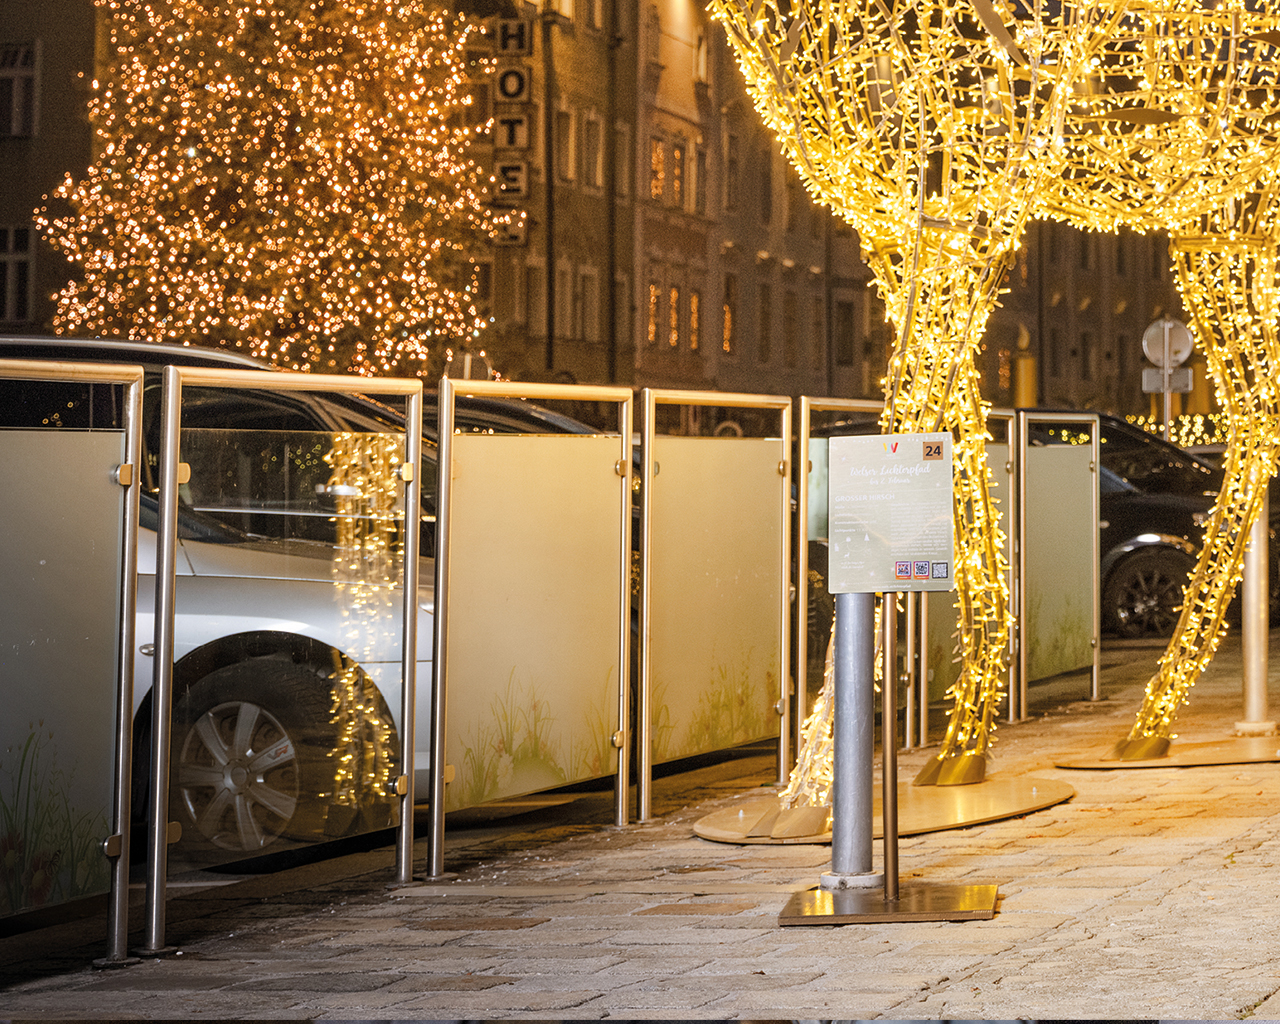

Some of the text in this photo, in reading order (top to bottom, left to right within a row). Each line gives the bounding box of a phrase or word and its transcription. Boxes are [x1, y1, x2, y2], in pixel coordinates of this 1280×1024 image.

[925, 445, 942, 457] 24
[850, 466, 877, 477] Welser
[834, 493, 895, 503] GROSSER HIRSCH
